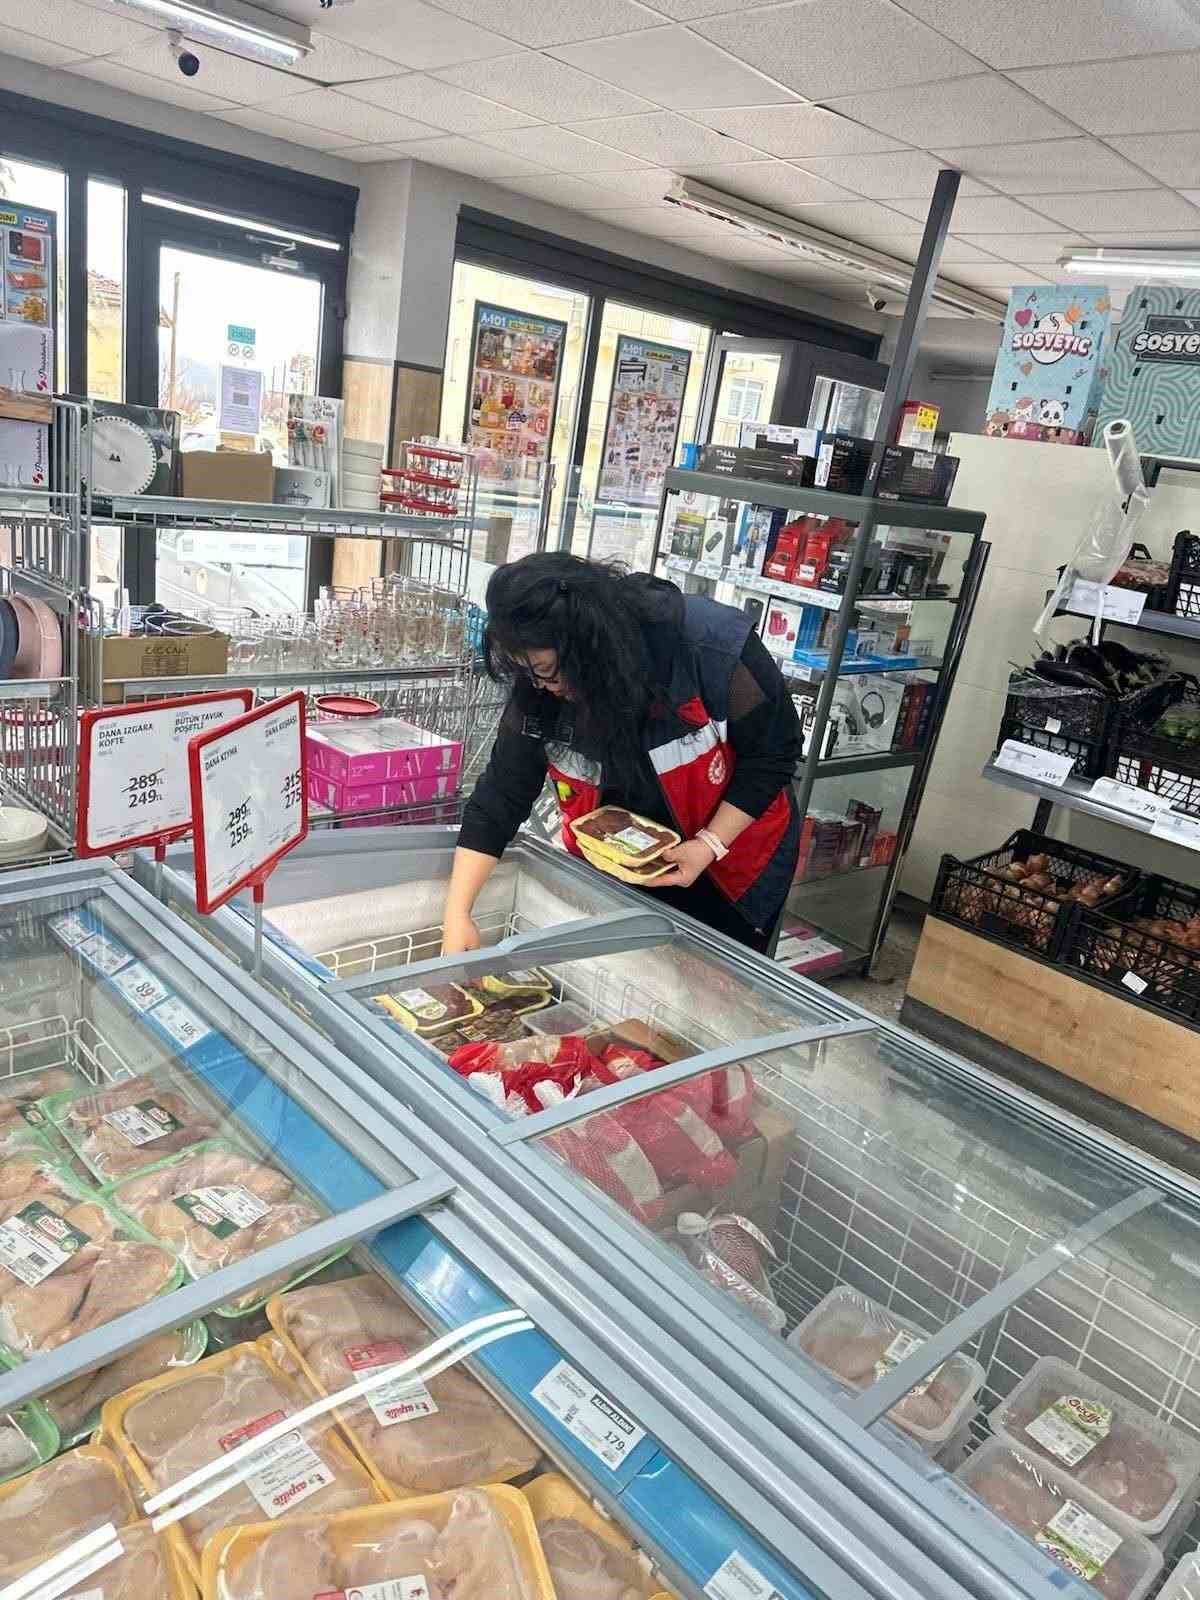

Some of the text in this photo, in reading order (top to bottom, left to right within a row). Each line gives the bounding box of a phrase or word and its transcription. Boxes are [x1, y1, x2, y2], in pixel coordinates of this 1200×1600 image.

[1012, 332, 1092, 356] SOSYETIC
[1134, 331, 1200, 355] SOSYe
[201, 711, 224, 721] TAVUK
[99, 729, 121, 740] DANA
[205, 758, 220, 771] DANA
[230, 822, 249, 848] 259
[604, 1431, 625, 1451] 179
